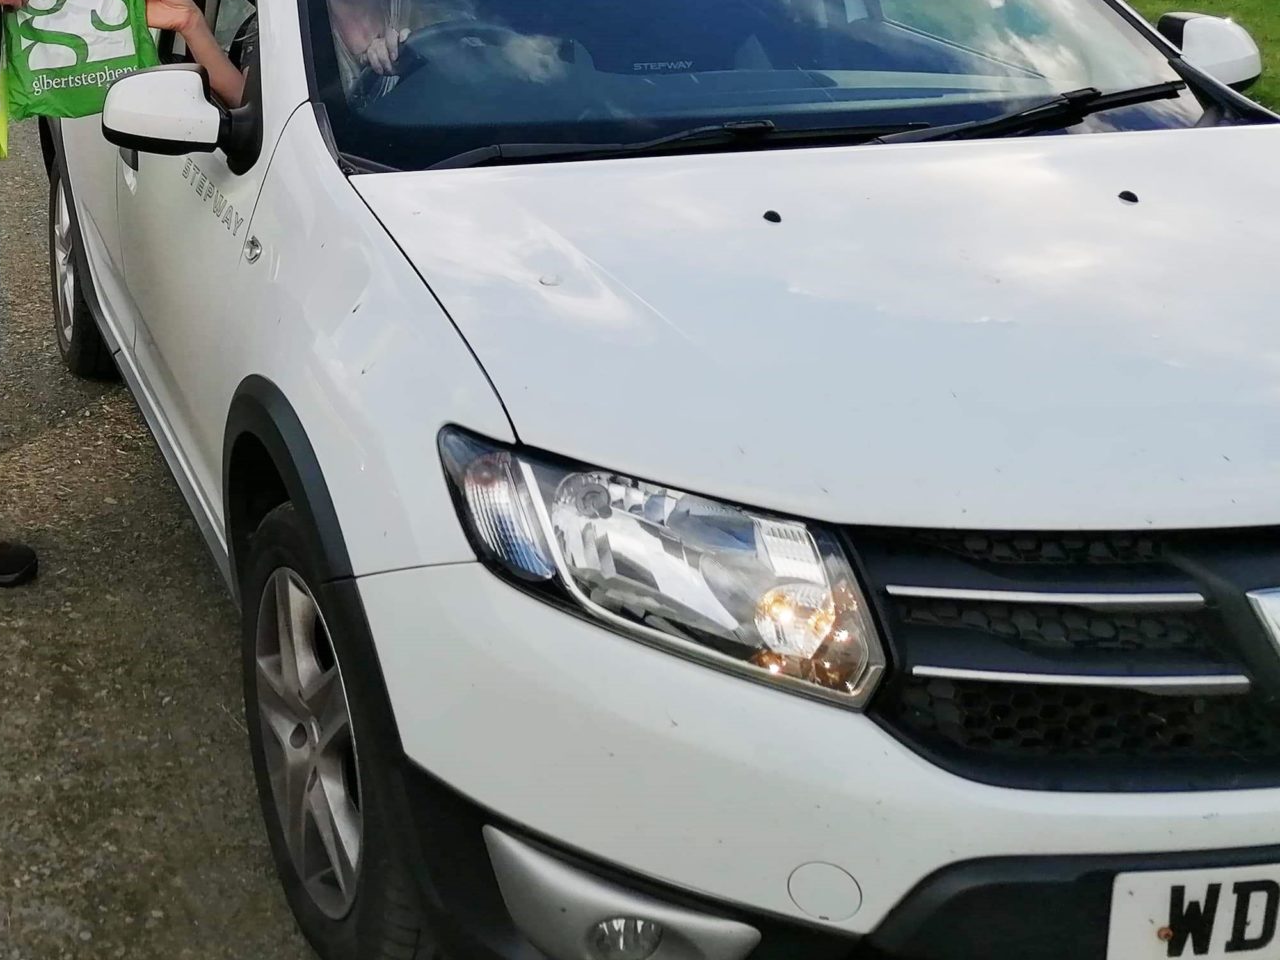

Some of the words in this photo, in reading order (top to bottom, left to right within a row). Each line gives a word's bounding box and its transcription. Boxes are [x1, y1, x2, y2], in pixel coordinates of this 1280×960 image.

[633, 60, 693, 71] STEPWAY
[181, 157, 244, 237] STEPWAY
[1167, 879, 1280, 958] WD
